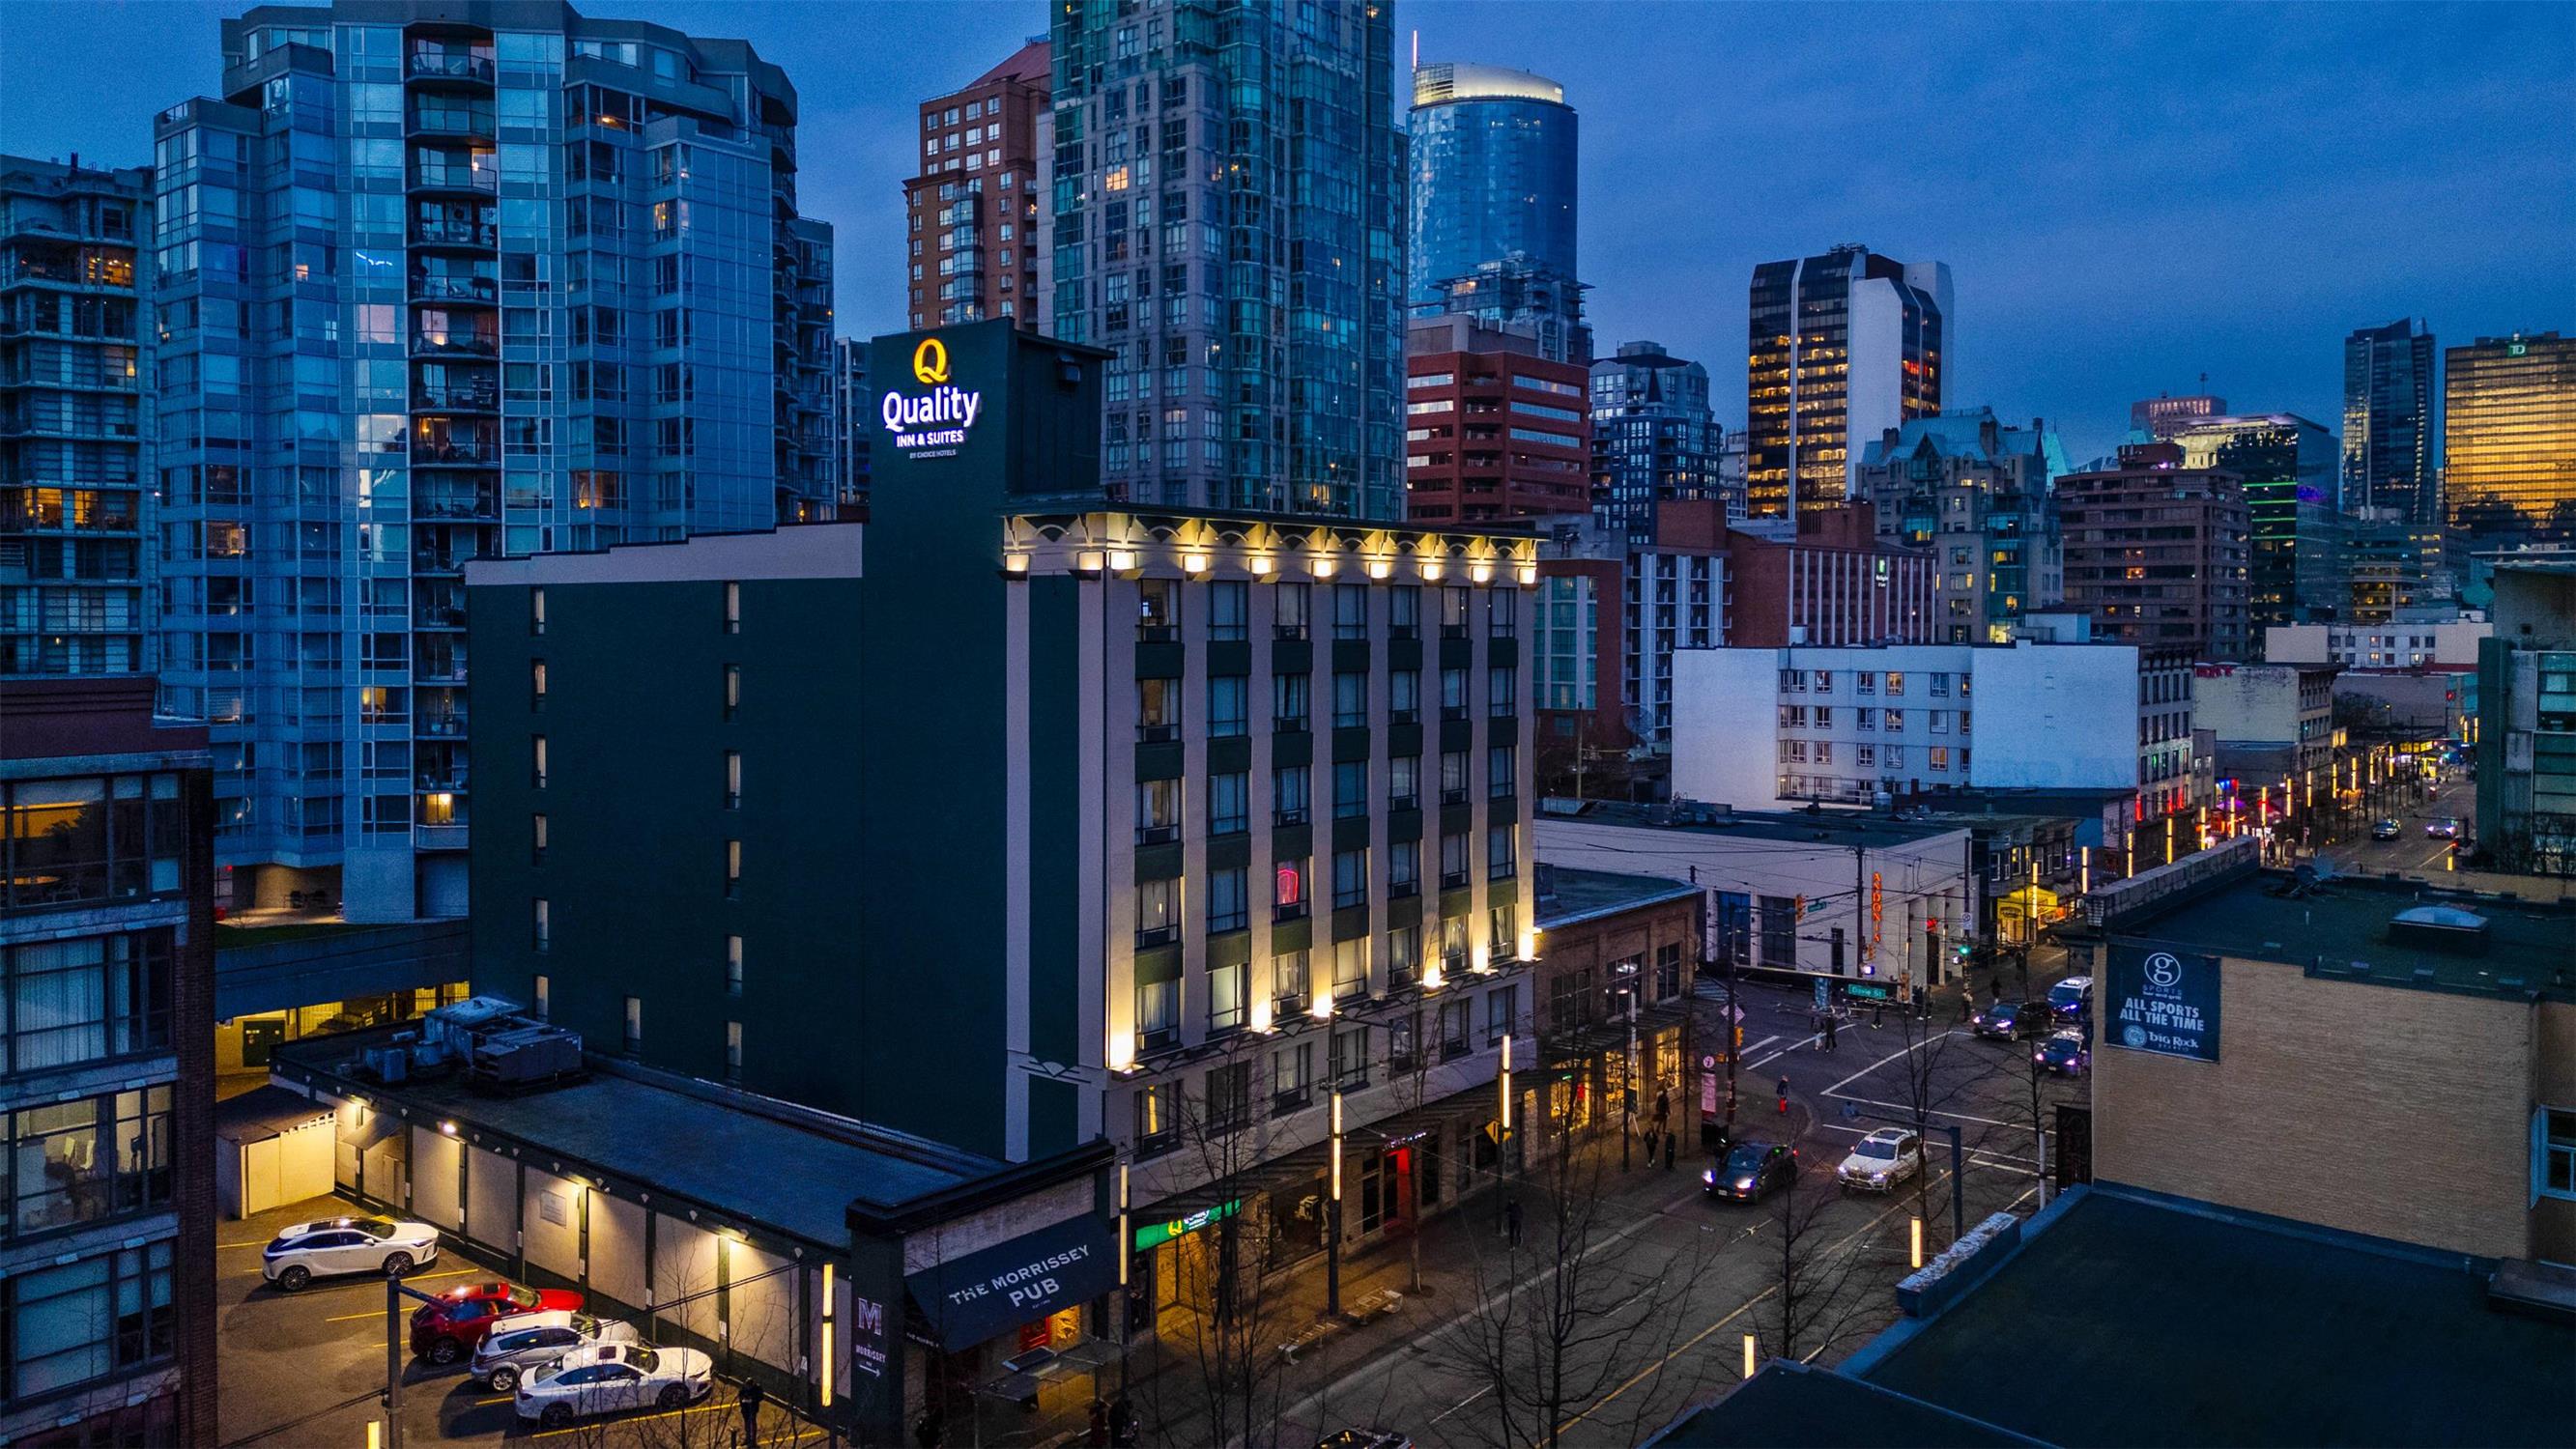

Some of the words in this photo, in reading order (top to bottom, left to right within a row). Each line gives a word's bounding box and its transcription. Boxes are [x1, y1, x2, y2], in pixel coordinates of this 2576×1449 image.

[914, 338, 948, 384] Q
[2509, 344, 2525, 355] TD
[883, 386, 979, 432] Quality
[897, 434, 915, 447] INN
[917, 434, 926, 445] &
[927, 430, 964, 444] SUITES
[2119, 1008, 2141, 1022] ALL
[2145, 1011, 2168, 1026] THE
[2172, 1015, 2204, 1031] TIME
[2125, 997, 2147, 1010] ALL
[2150, 1001, 2200, 1018] SPORTS
[949, 1283, 990, 1305] THE
[990, 1244, 1090, 1291] MORRISSEY
[1009, 1277, 1060, 1308] PUB
[858, 1297, 882, 1336] M
